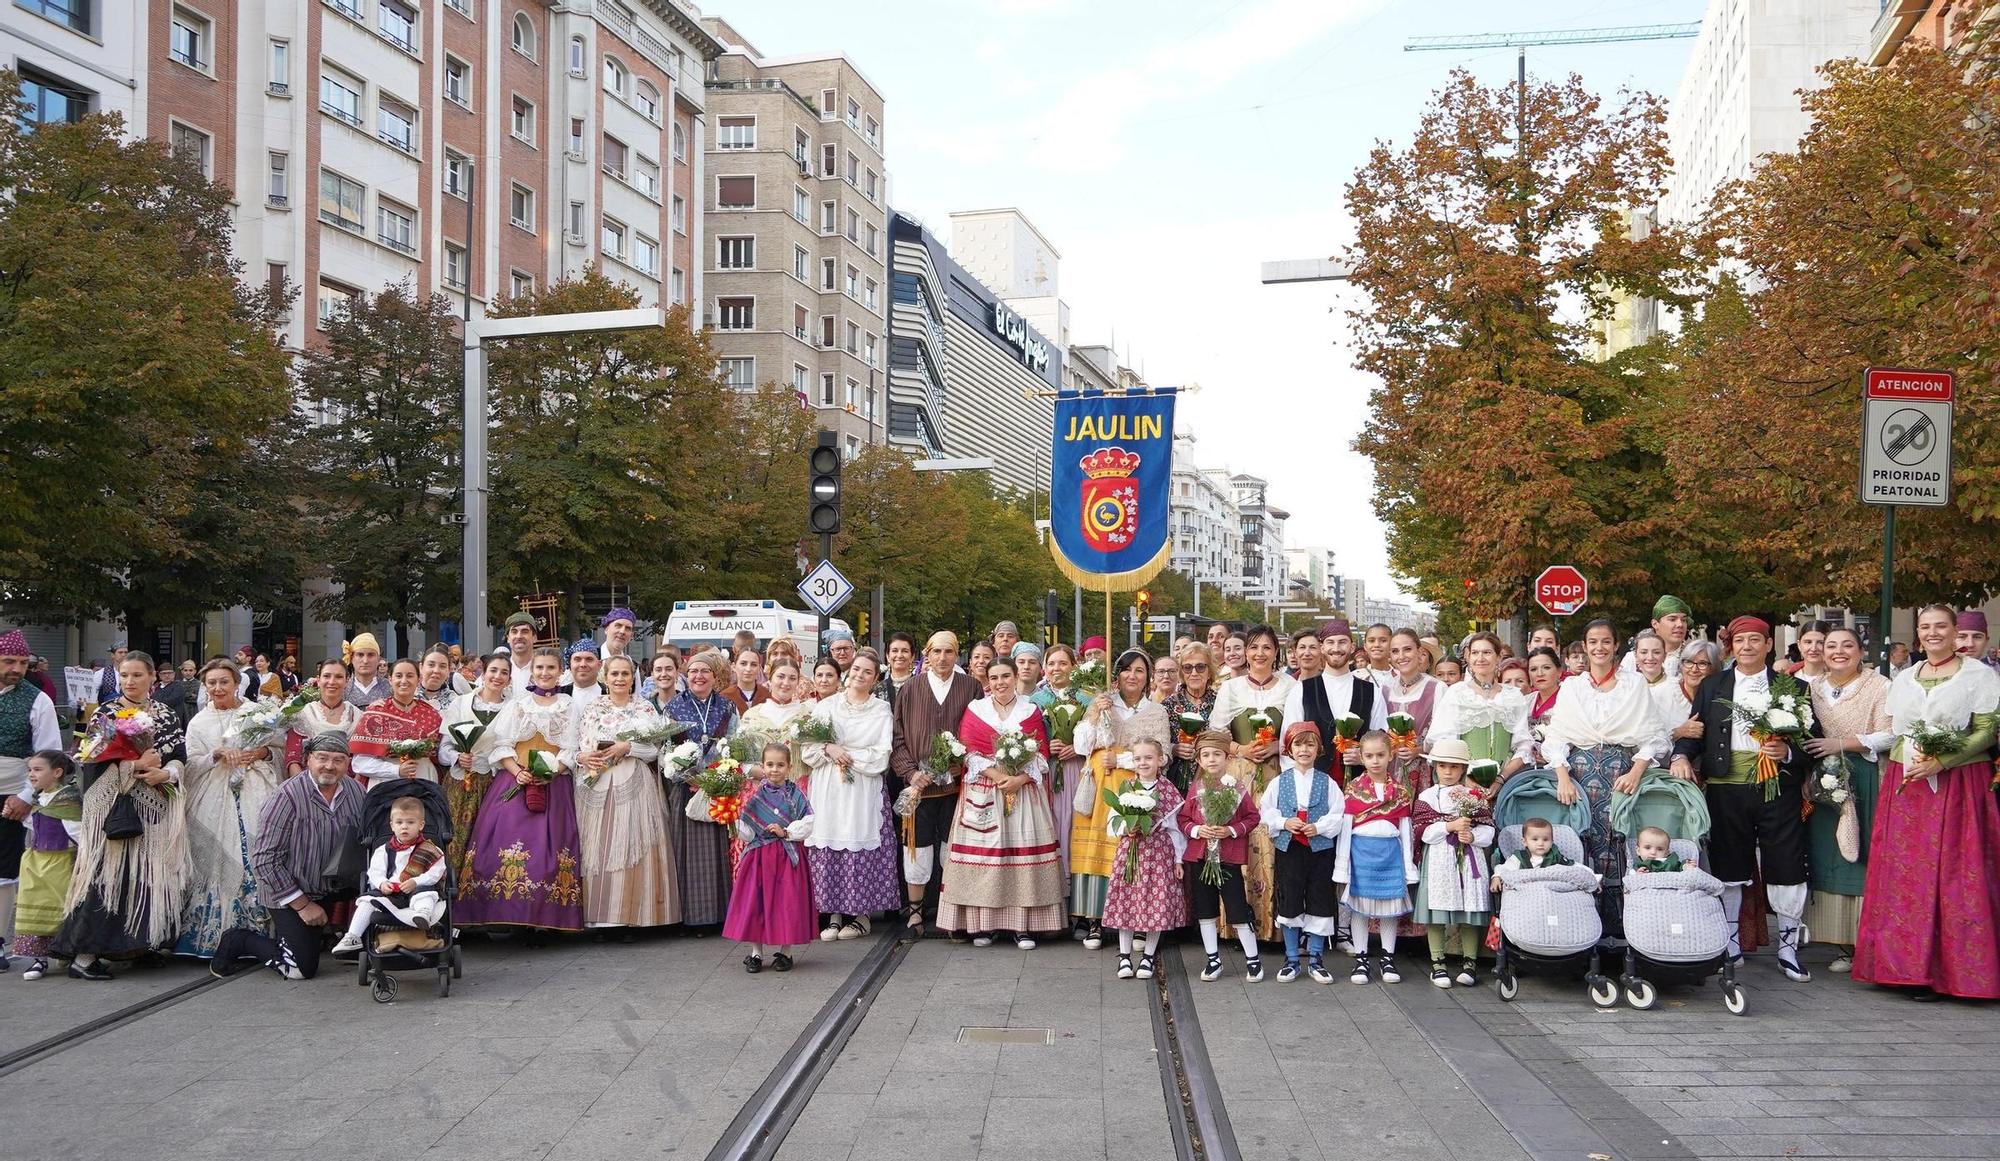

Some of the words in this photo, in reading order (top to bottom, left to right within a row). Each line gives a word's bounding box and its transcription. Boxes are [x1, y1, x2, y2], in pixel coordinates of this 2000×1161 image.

[995, 302, 1005, 335] El
[1878, 379, 1943, 391] ATENCIÓN
[1064, 414, 1162, 441] JAULIN
[1887, 424, 1930, 450] 20
[1873, 470, 1940, 481] PRIORIDAD
[1873, 486, 1938, 497] PEATONAL
[813, 578, 838, 597] 30
[1542, 584, 1582, 597] STOP
[681, 620, 764, 631] AMBULANCIA
